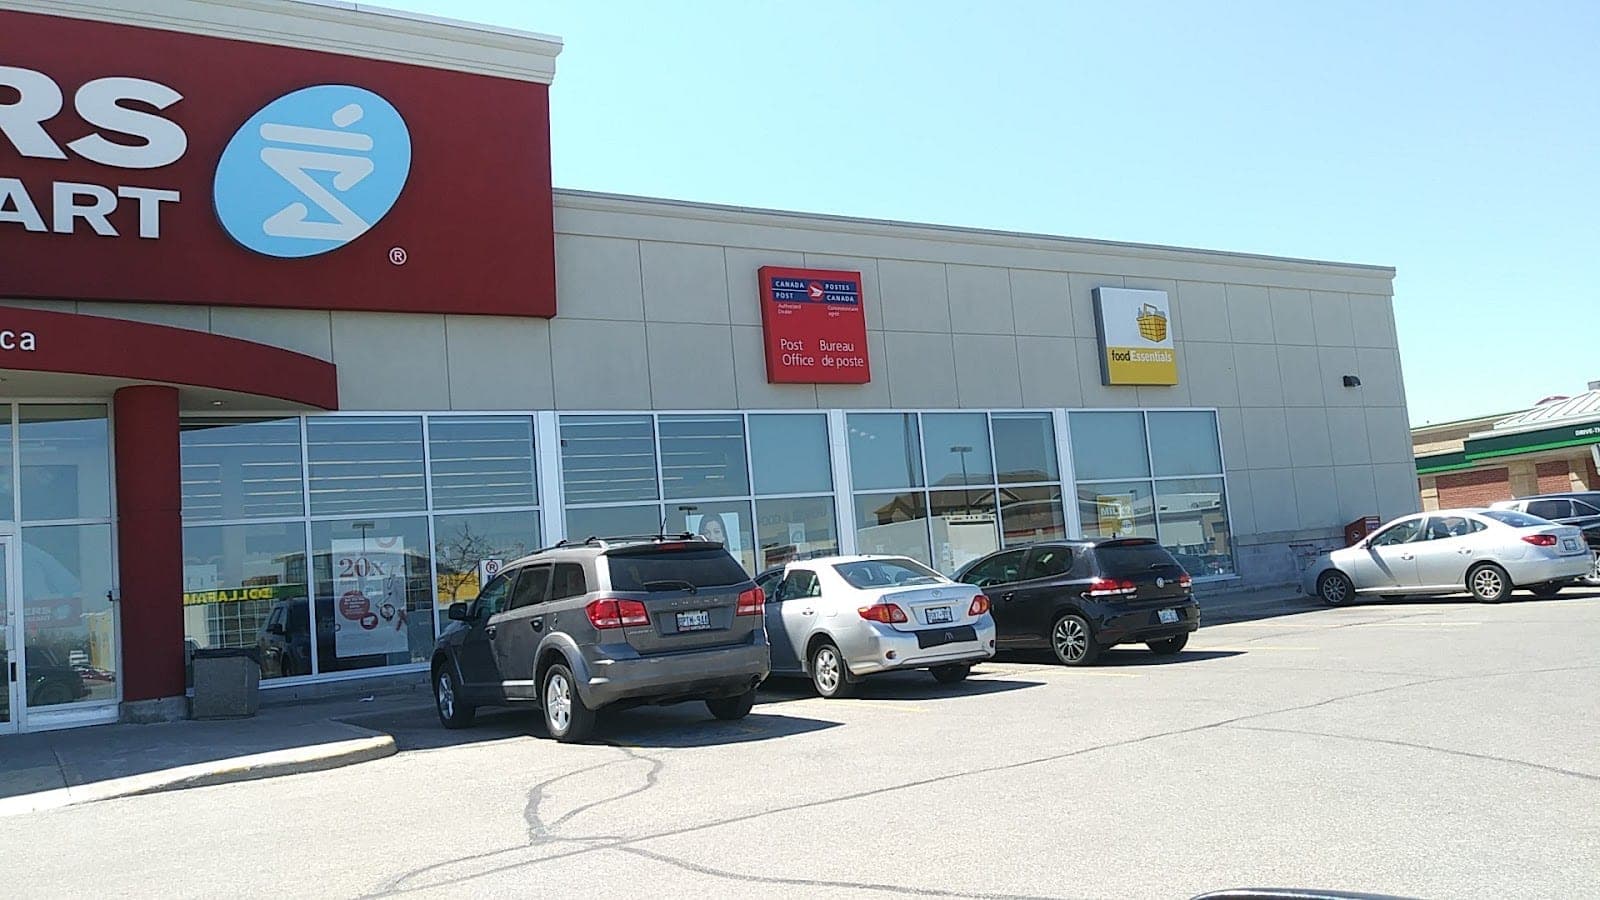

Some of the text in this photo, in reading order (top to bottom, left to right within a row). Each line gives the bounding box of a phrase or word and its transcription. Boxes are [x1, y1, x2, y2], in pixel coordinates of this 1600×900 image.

[775, 281, 805, 289] CANADA
[825, 283, 850, 291] POSTES
[780, 339, 803, 351] Post
[819, 339, 854, 352] Bureau
[782, 353, 814, 366] Office
[821, 355, 864, 369] de poste
